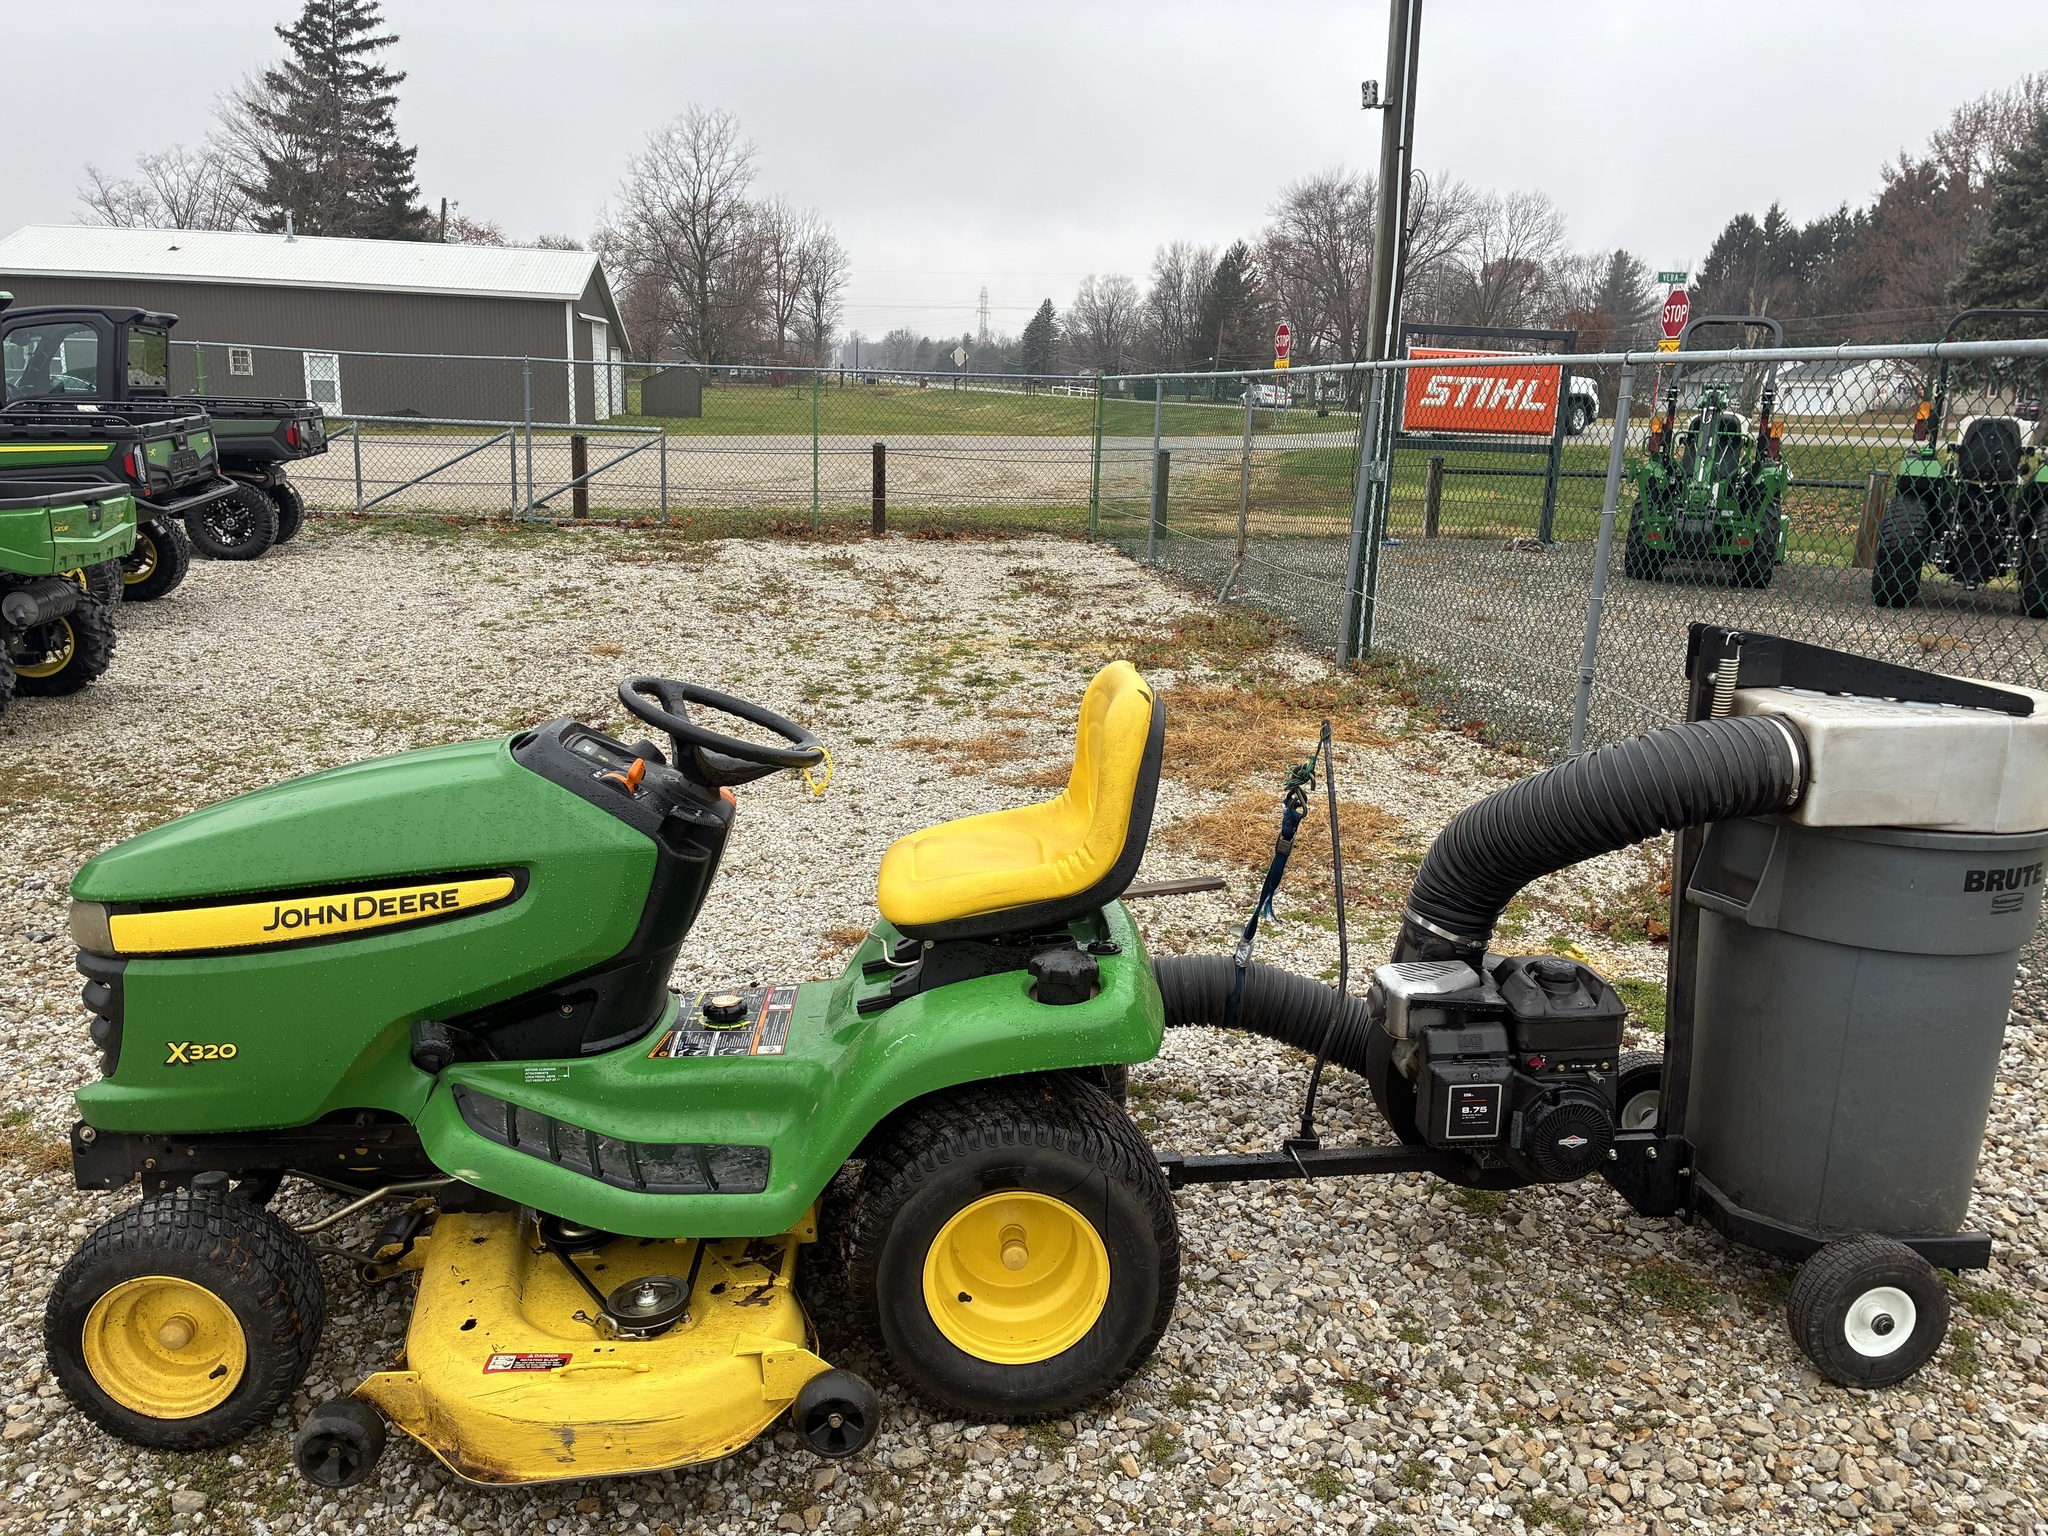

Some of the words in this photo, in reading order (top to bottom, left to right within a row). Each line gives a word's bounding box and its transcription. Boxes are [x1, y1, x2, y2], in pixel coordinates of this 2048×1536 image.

[1662, 273, 1679, 282] VERA
[1663, 304, 1688, 323] STOP
[1276, 334, 1290, 347] STOP
[1419, 375, 1547, 411] STIHL
[1963, 861, 2044, 893] BRUTE
[263, 903, 348, 931] JOHN
[353, 889, 460, 920] DEERE
[165, 1041, 237, 1064] X320
[1461, 1105, 1488, 1114] 8.75
